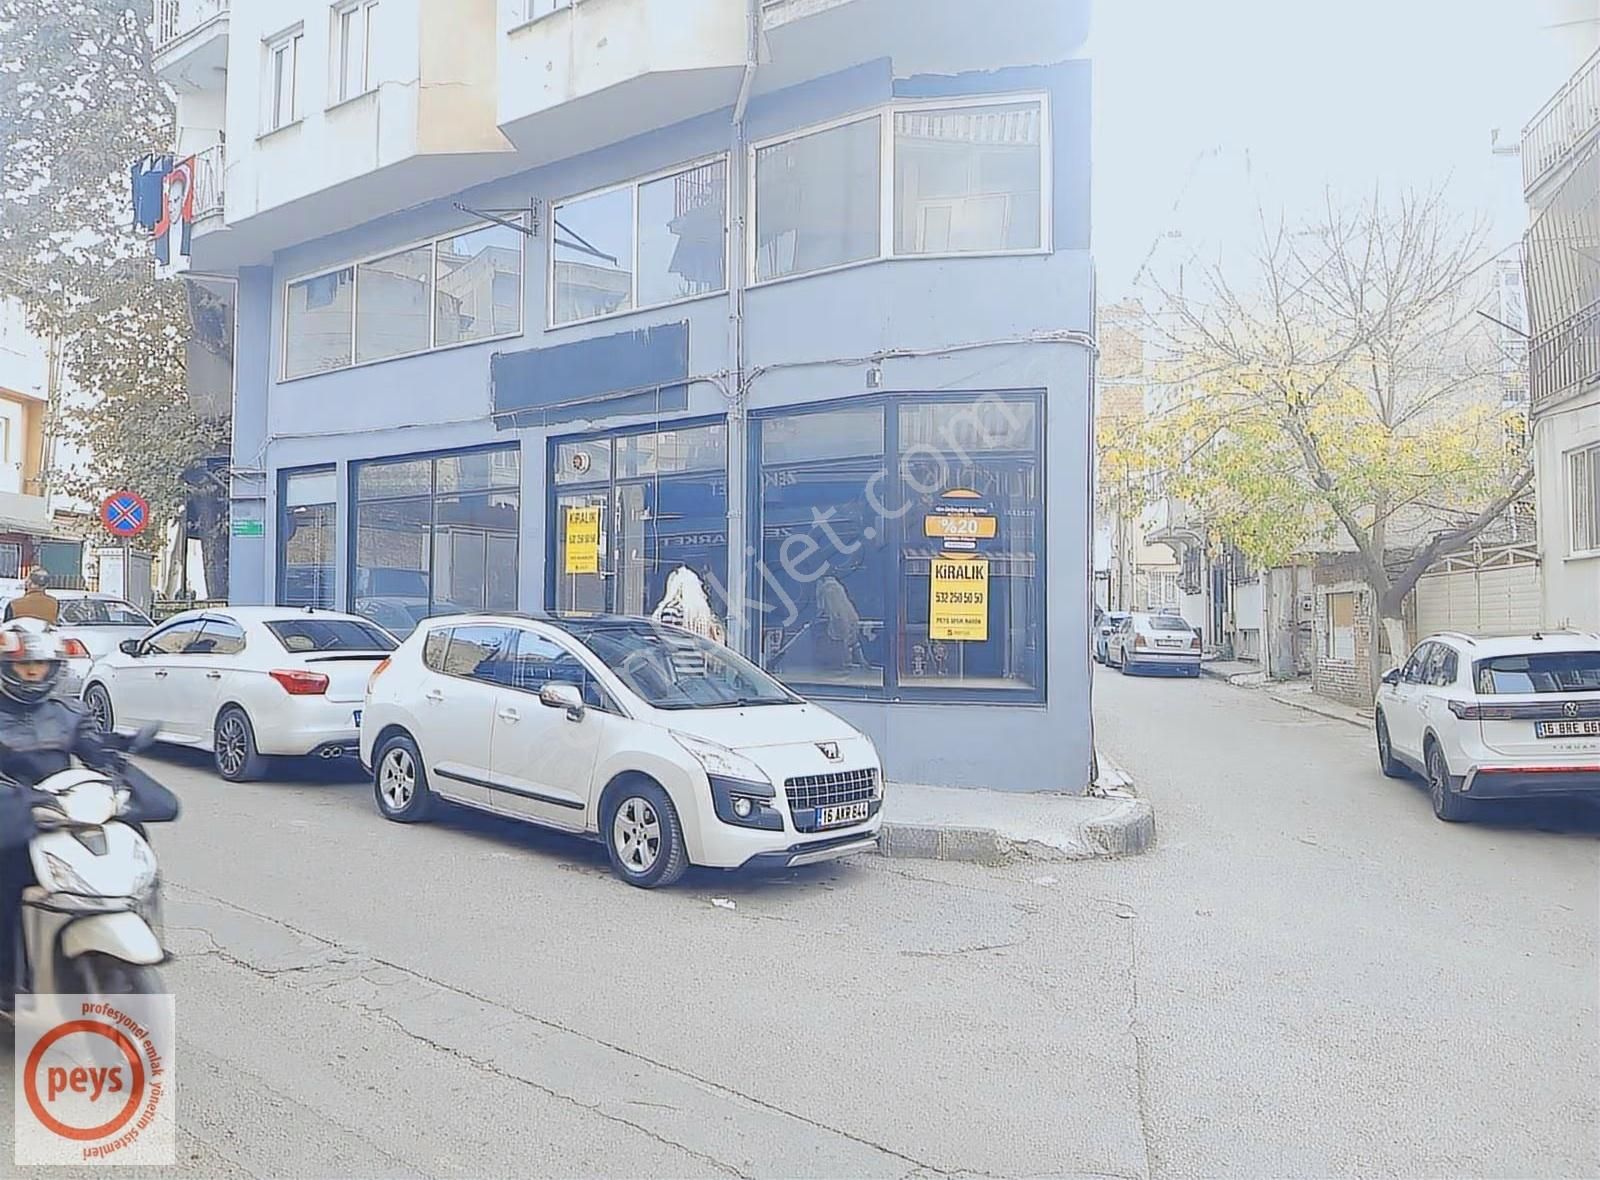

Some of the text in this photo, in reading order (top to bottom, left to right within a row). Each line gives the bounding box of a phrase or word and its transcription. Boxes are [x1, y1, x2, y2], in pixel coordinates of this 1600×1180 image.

[941, 519, 978, 535] %20
[1543, 723, 1554, 734] 16
[824, 809, 833, 823] 16
